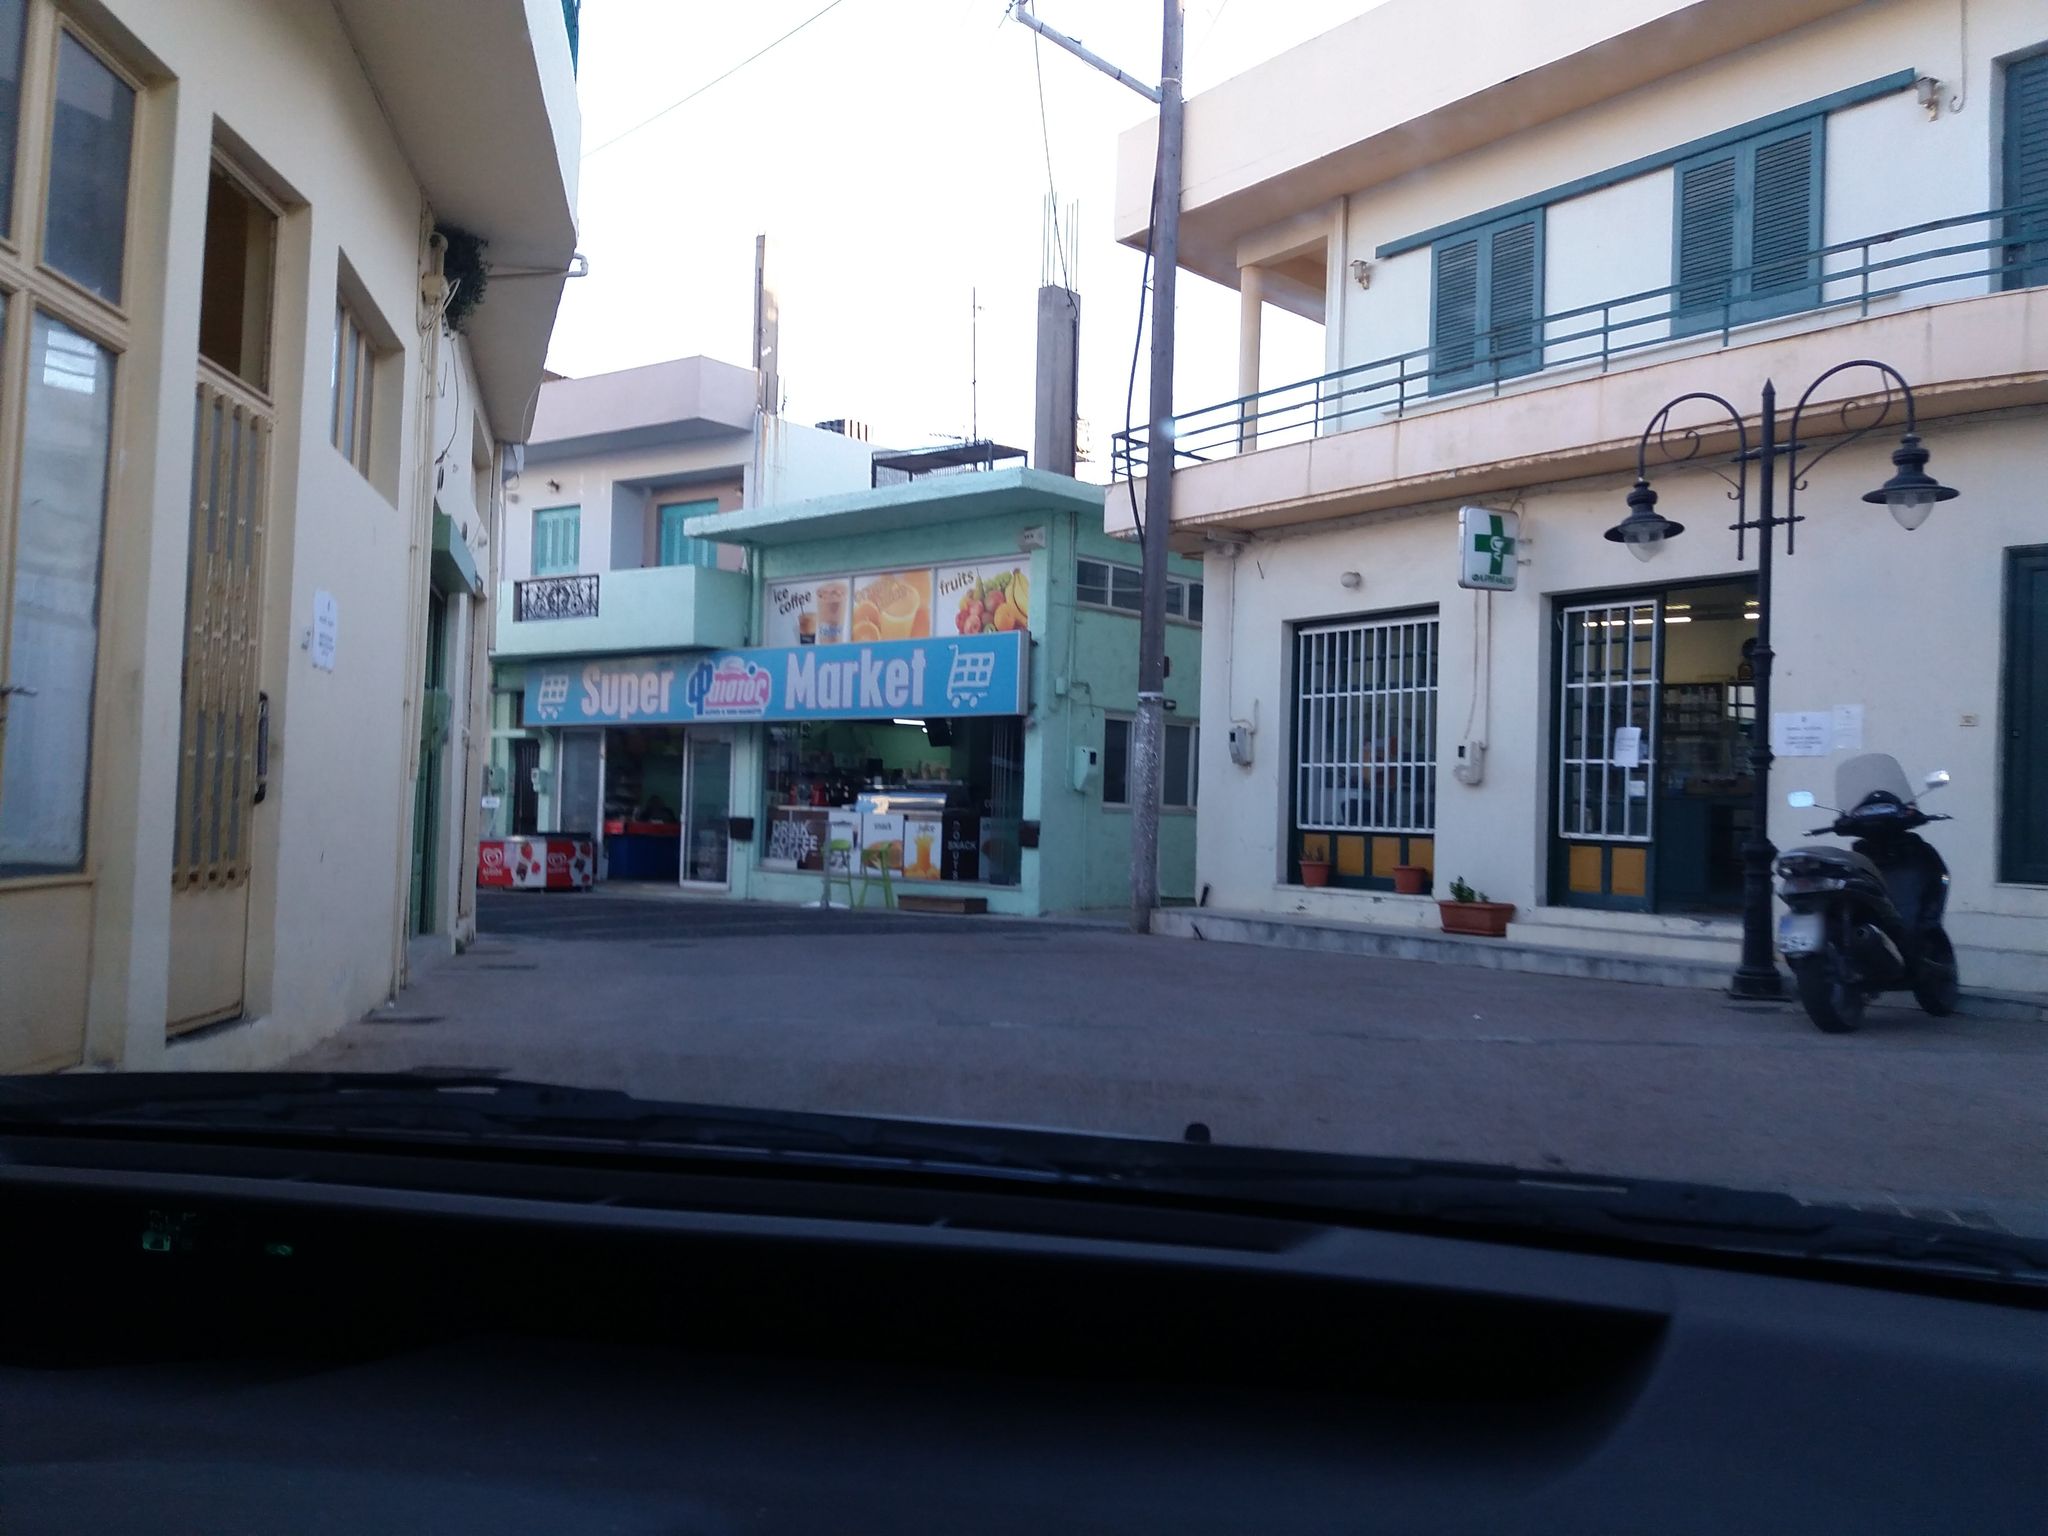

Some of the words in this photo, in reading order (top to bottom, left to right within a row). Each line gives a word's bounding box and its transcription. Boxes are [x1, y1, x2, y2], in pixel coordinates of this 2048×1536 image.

[939, 570, 974, 596] fruits
[772, 587, 789, 604] ice
[778, 590, 812, 616] coffee
[784, 648, 927, 711] Market
[581, 665, 675, 720] Super
[772, 820, 811, 839] DRINK
[771, 833, 818, 851] COFFEE
[769, 847, 810, 863] ENJOY
